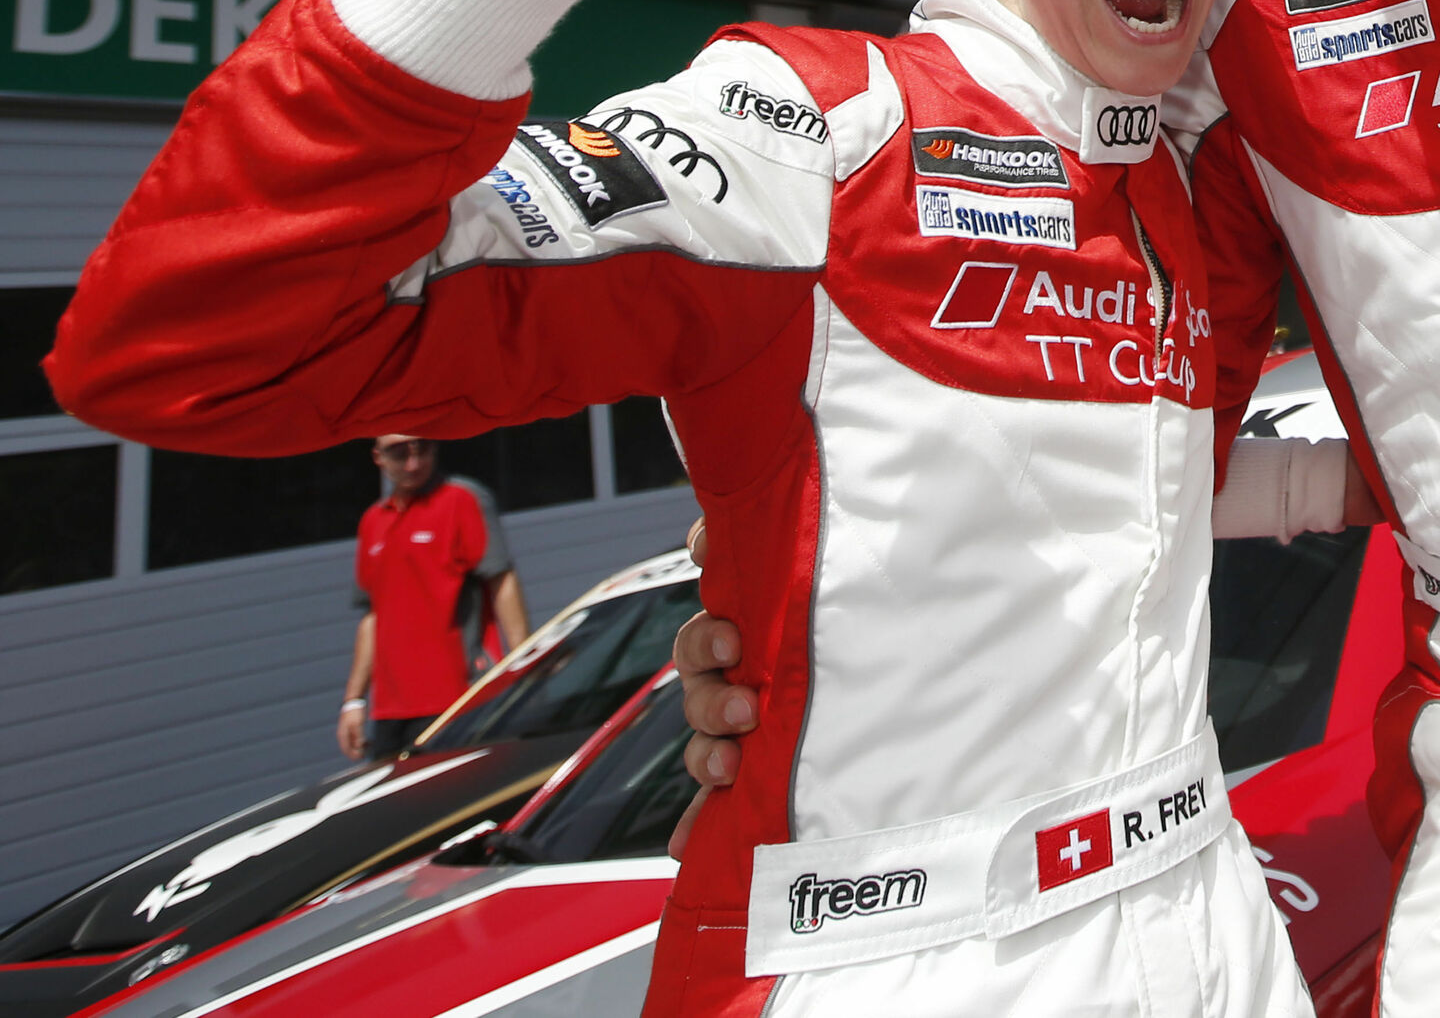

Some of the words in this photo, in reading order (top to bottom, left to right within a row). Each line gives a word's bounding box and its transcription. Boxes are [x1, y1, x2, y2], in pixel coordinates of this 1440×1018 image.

[1321, 14, 1429, 61] sportscars
[724, 83, 827, 139] freem
[973, 163, 1035, 177] PERFORMANCE
[955, 207, 1071, 242] sportscars
[1023, 271, 1136, 325] Audi
[1025, 335, 1093, 383] TT
[1123, 811, 1153, 848] R.
[1159, 778, 1207, 833] FREY
[794, 872, 923, 918] freem
